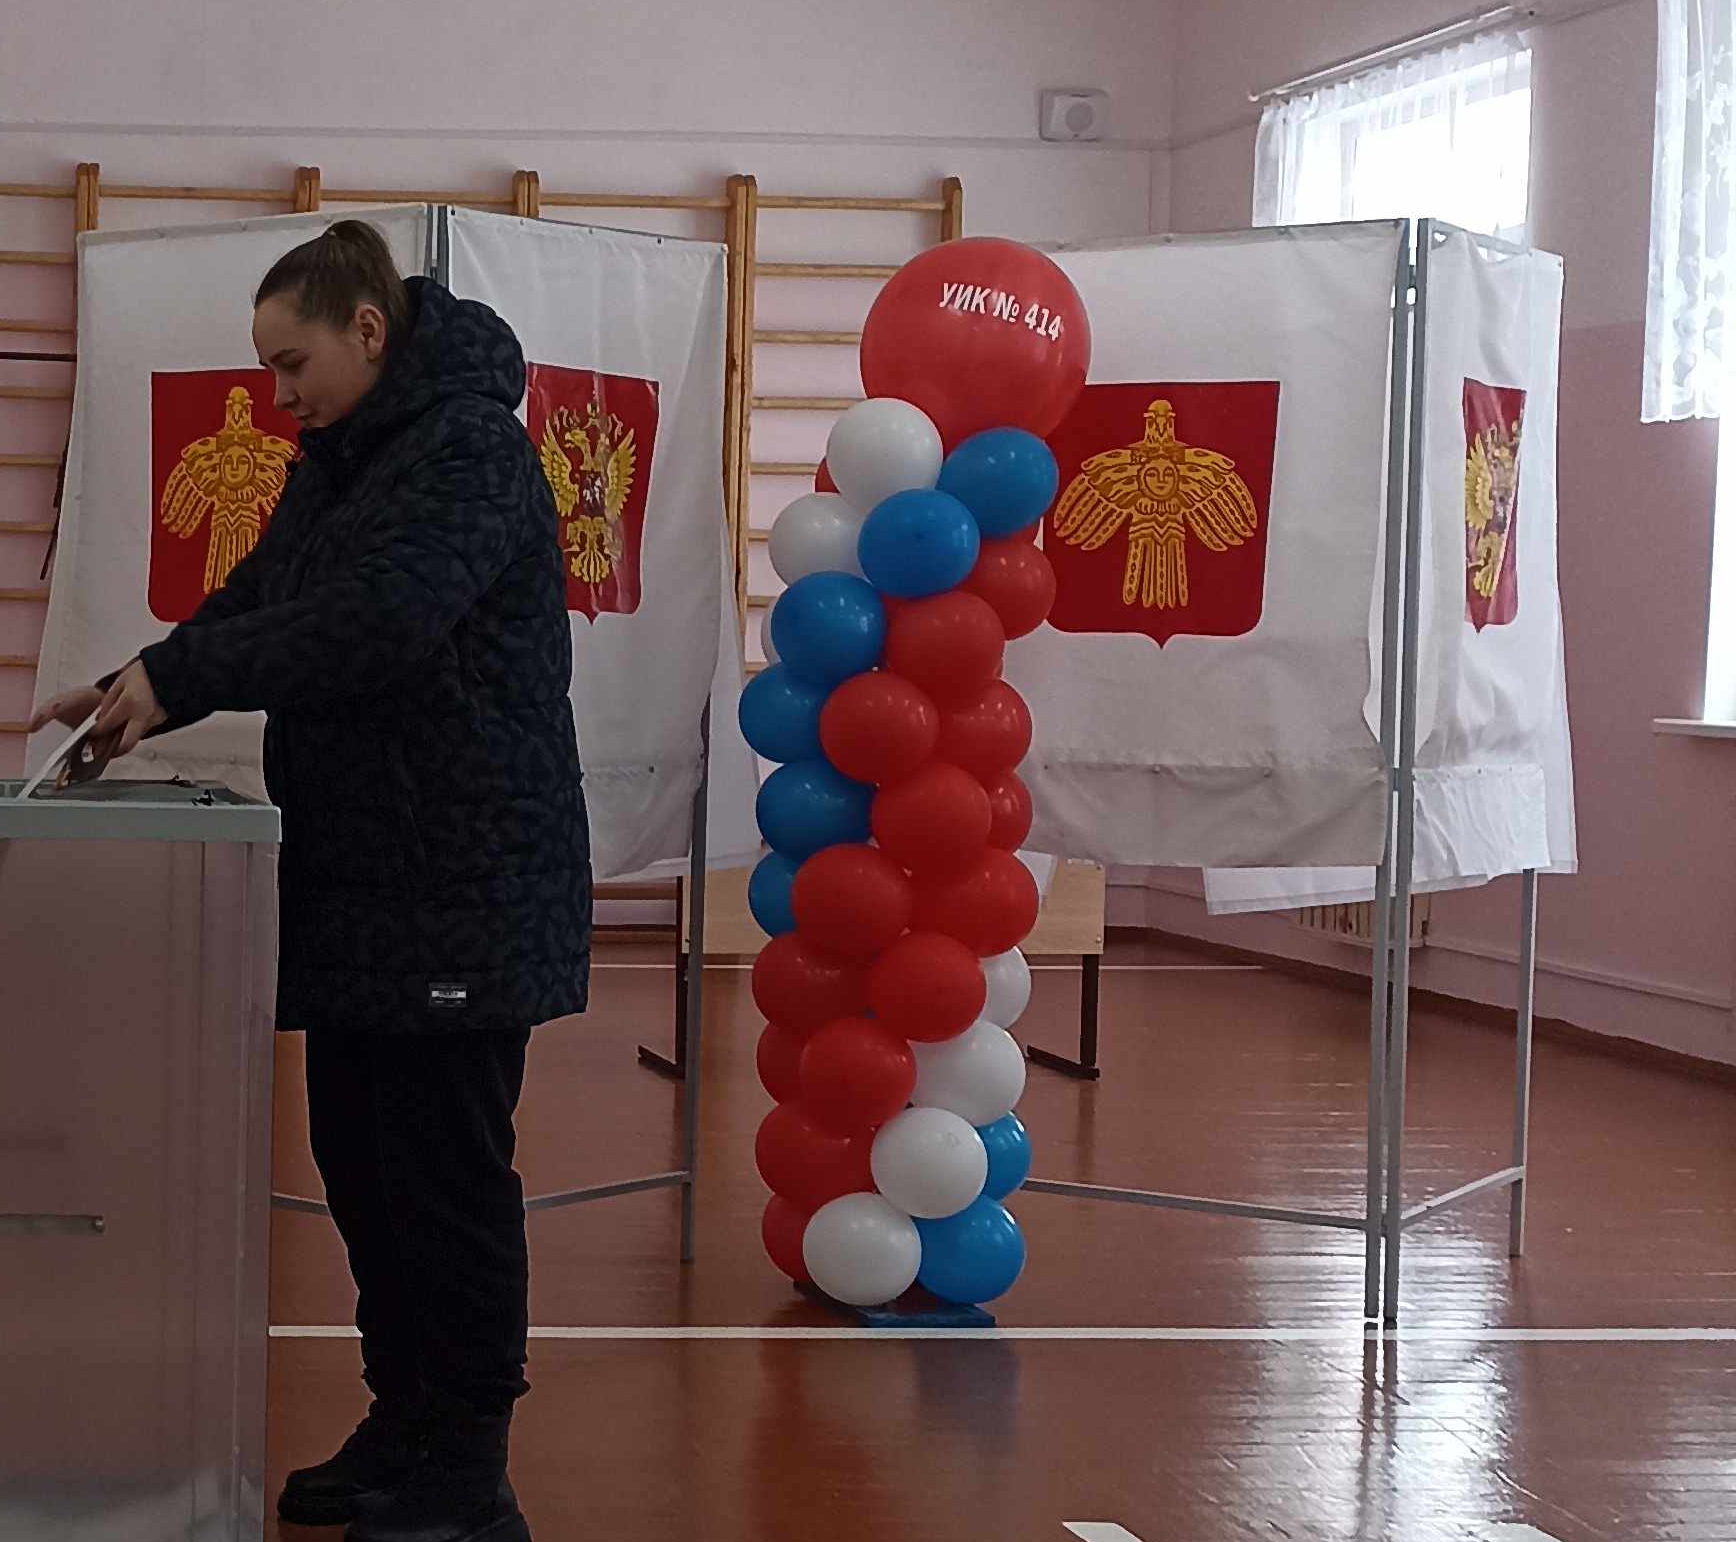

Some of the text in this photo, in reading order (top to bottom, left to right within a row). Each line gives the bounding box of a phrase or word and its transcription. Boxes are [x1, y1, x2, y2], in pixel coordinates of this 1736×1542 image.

[939, 282, 1062, 341] УИК № 414
